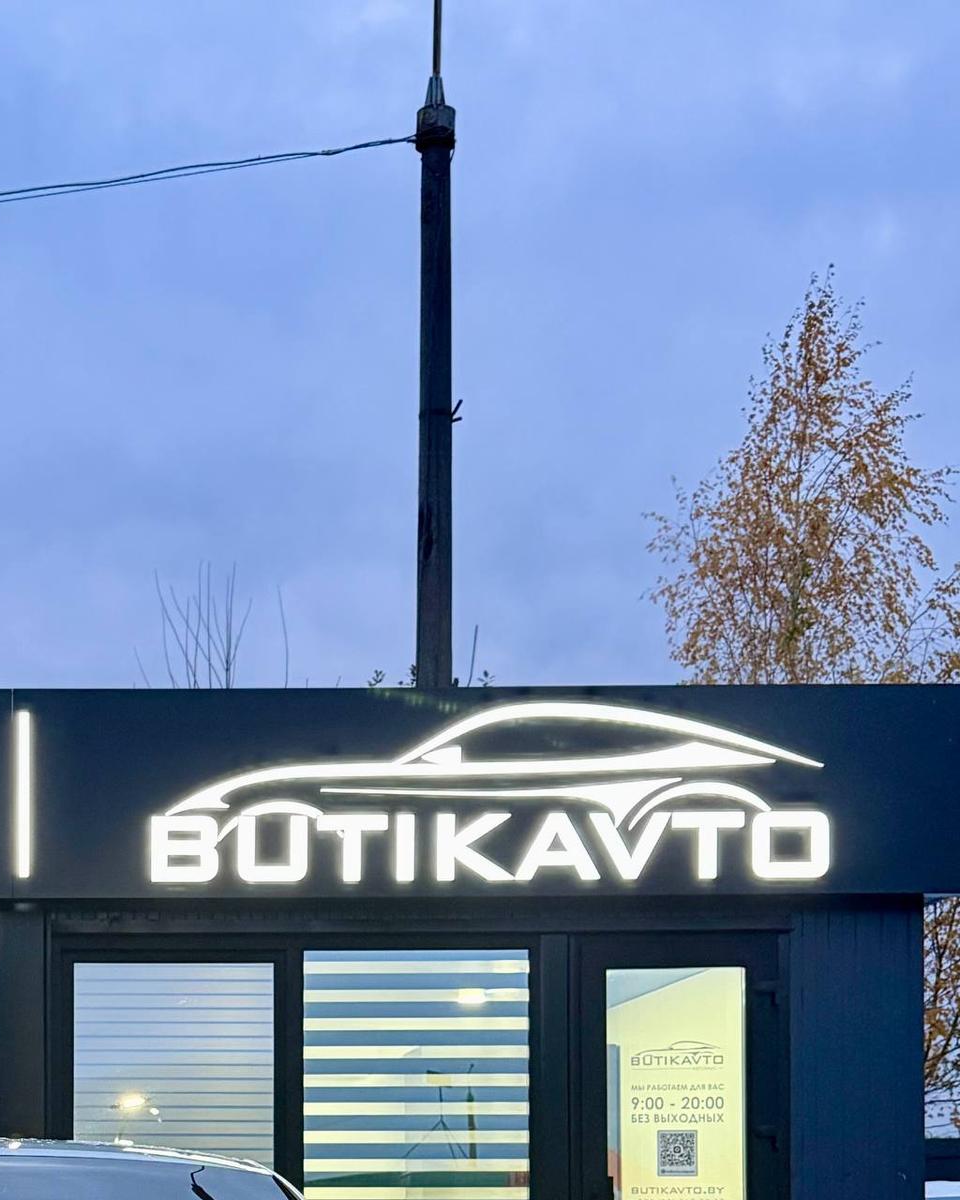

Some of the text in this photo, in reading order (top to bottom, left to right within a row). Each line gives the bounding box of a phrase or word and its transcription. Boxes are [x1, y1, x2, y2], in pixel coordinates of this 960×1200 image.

[150, 809, 831, 883] BUTIKAVTO
[630, 1055, 724, 1066] BUTIKAVTO
[631, 1096, 664, 1110] 9:00
[681, 1096, 725, 1110] 20:00
[631, 1113, 724, 1124] БЕЗ ВЫХОДНЫХ
[631, 1186, 725, 1195] BUTIKAVTO.BY
